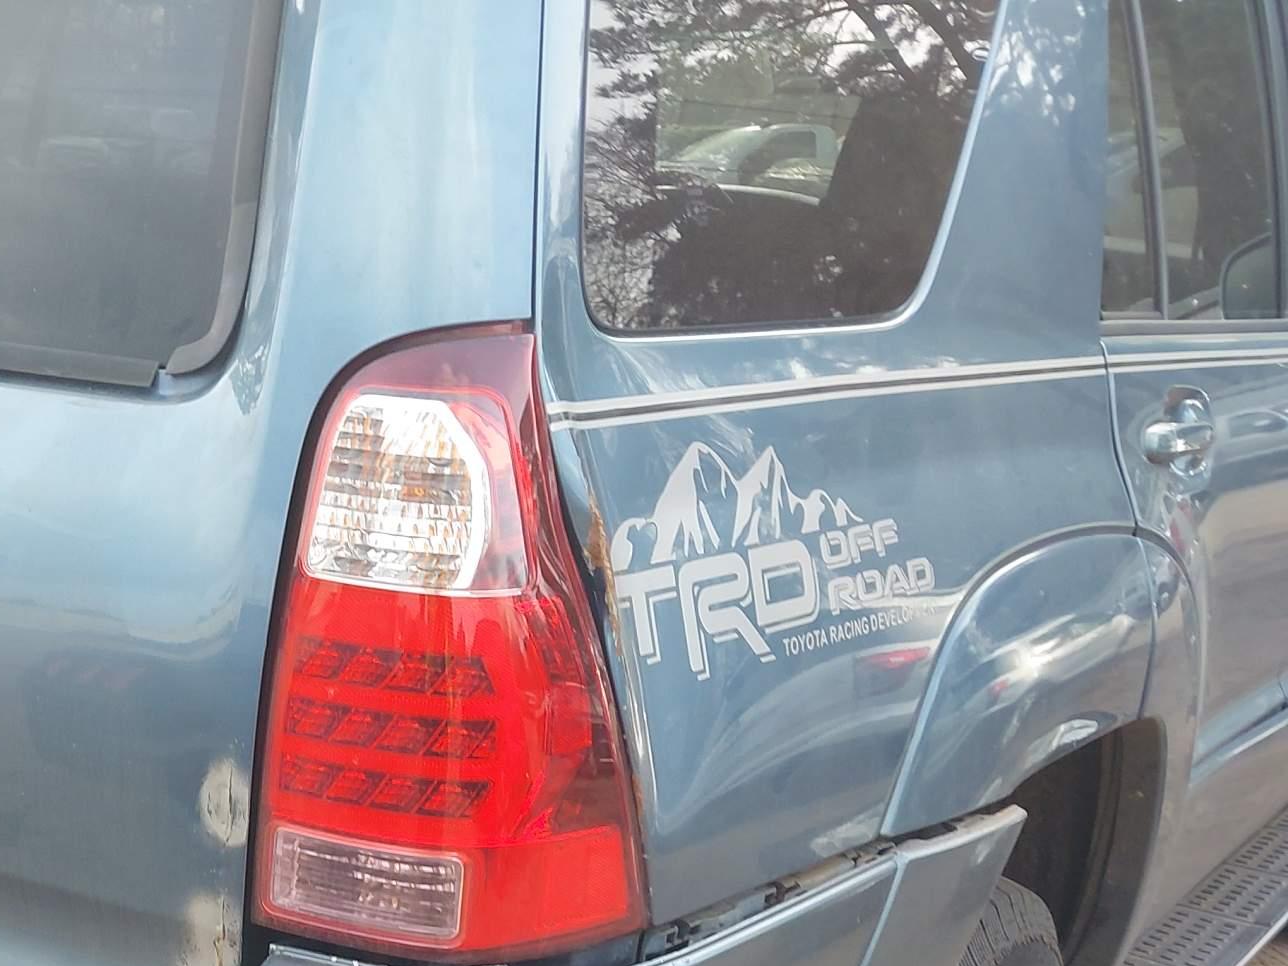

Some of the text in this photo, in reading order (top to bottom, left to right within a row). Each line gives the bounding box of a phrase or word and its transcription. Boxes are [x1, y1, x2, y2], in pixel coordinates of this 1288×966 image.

[819, 518, 899, 569] OFF
[613, 538, 820, 681] TRD
[828, 557, 936, 615] ROAD
[782, 628, 829, 657] TOYOTA
[829, 615, 870, 645] RACING
